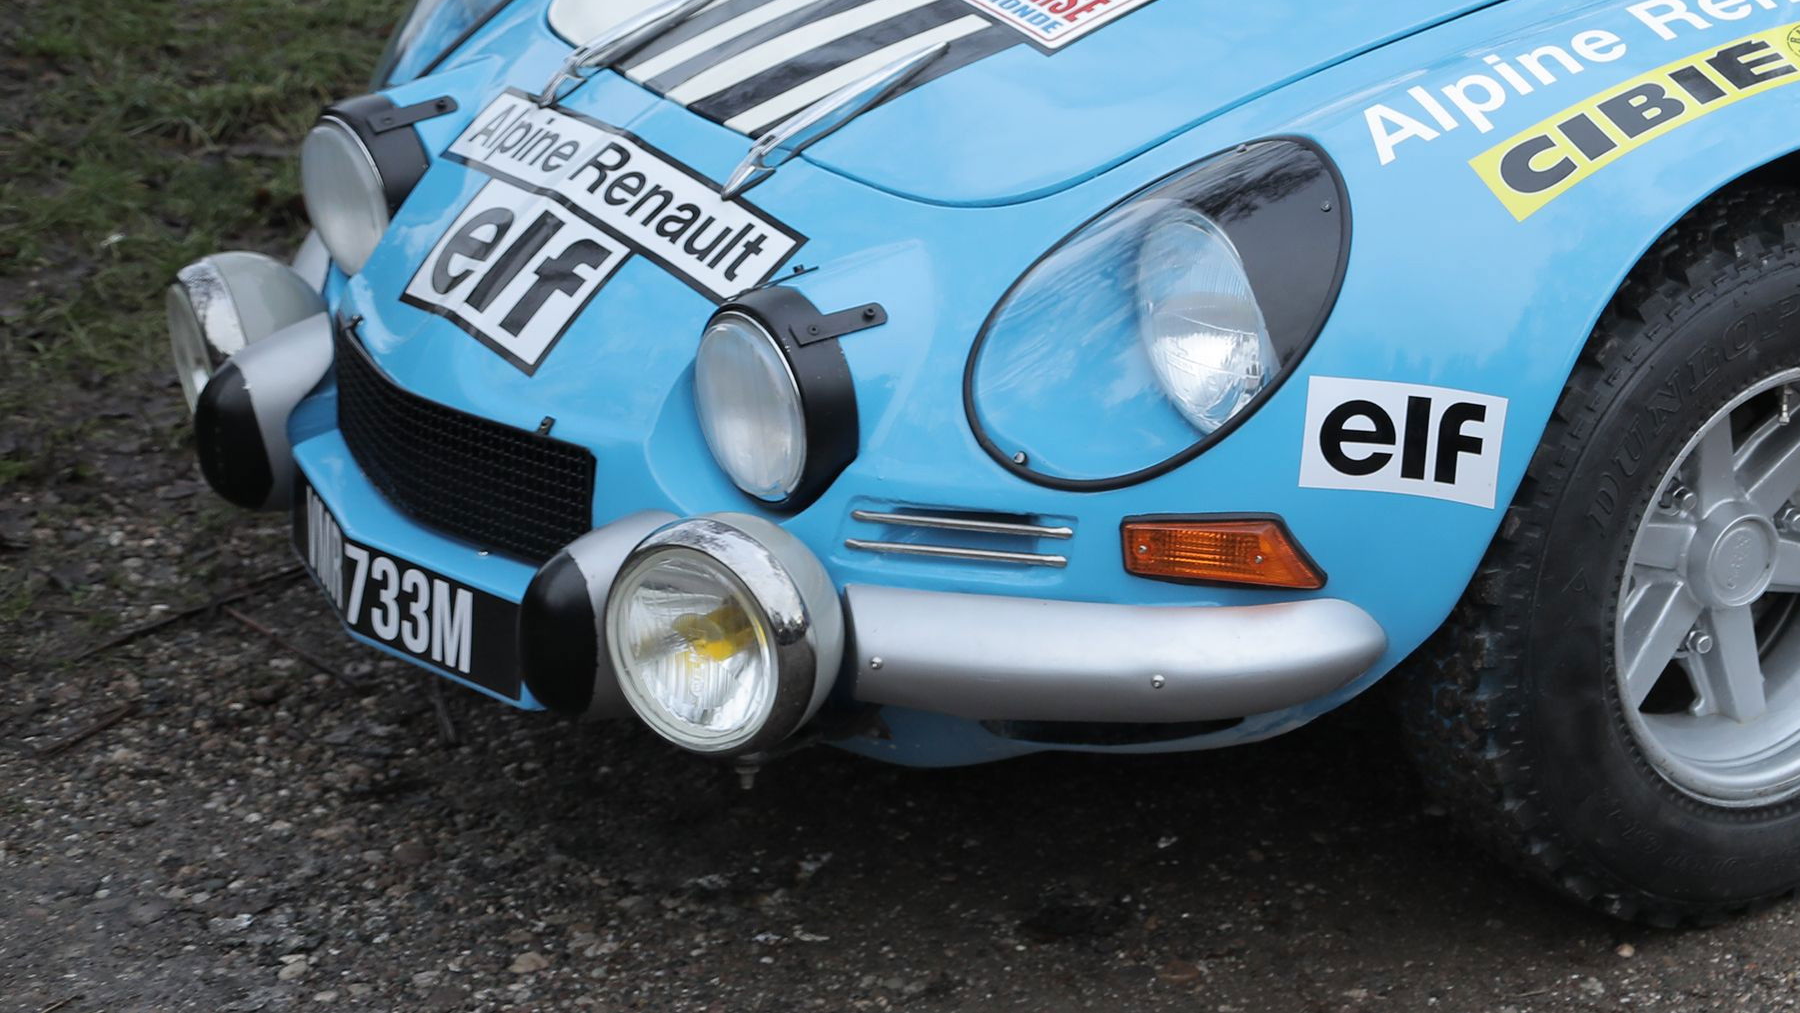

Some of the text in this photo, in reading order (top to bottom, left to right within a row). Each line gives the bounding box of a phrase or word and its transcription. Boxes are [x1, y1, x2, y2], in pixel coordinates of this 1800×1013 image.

[1363, 29, 1627, 166] Alpine
[468, 103, 769, 283] Alpine Renault
[432, 207, 614, 338] elf
[1319, 395, 1487, 485] elf
